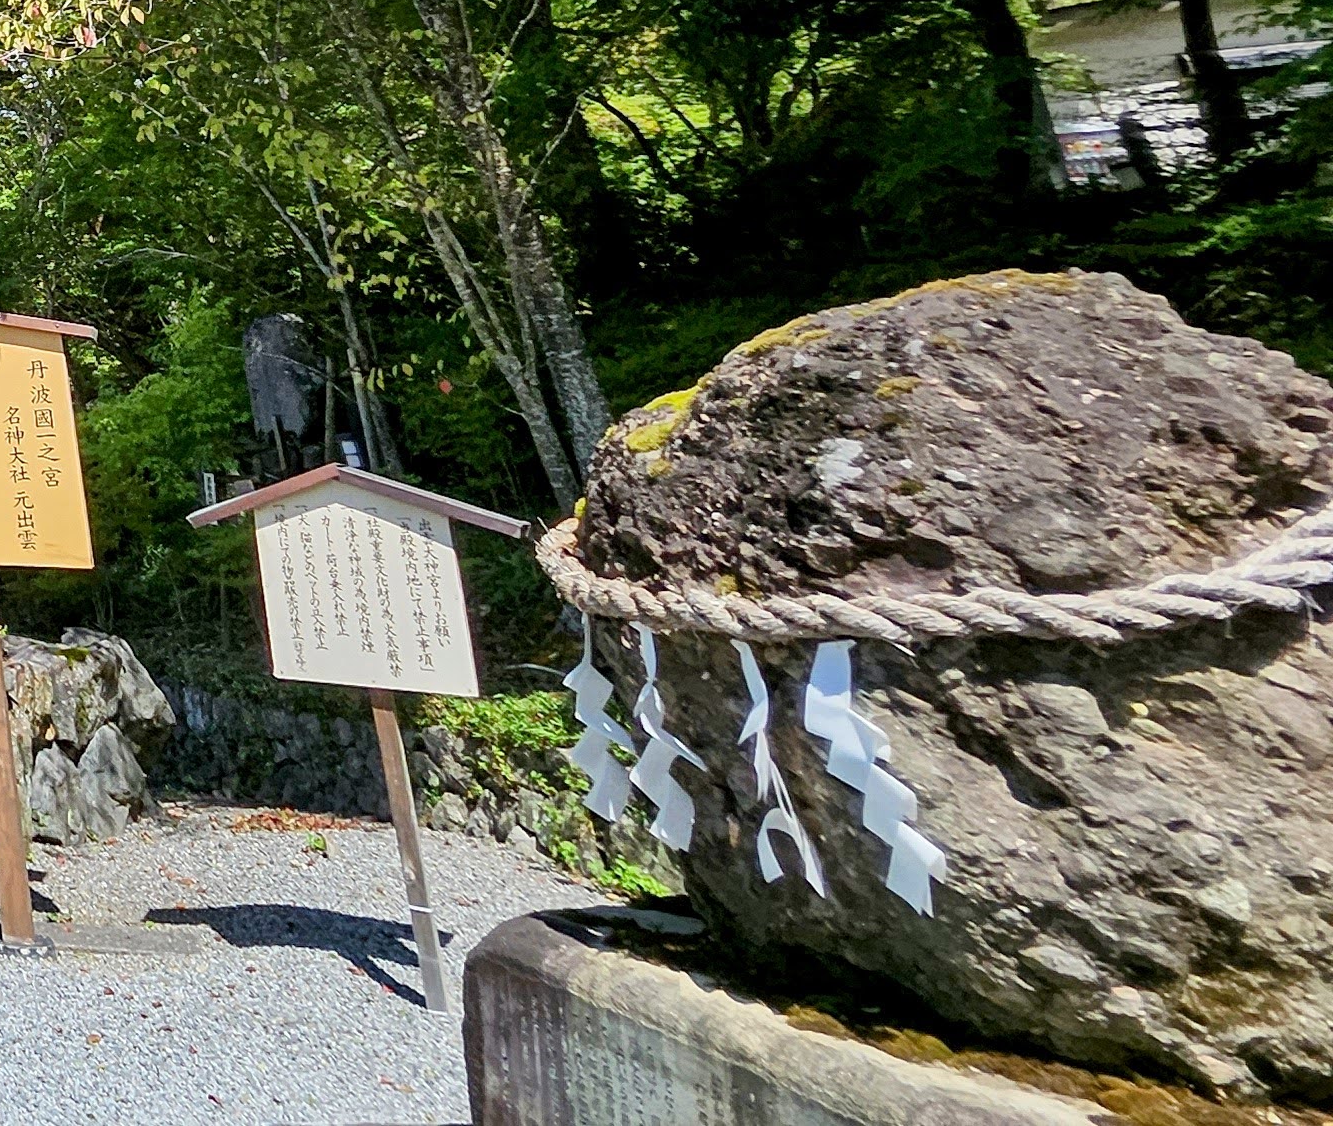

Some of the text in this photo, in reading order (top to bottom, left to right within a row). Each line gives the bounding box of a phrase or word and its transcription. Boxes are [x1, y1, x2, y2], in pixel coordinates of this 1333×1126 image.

[3, 406, 37, 551] 名神大社 元出雲
[27, 359, 62, 488] 丹波國一之宮
[419, 517, 451, 648] 出雲大神宮よりお願い
